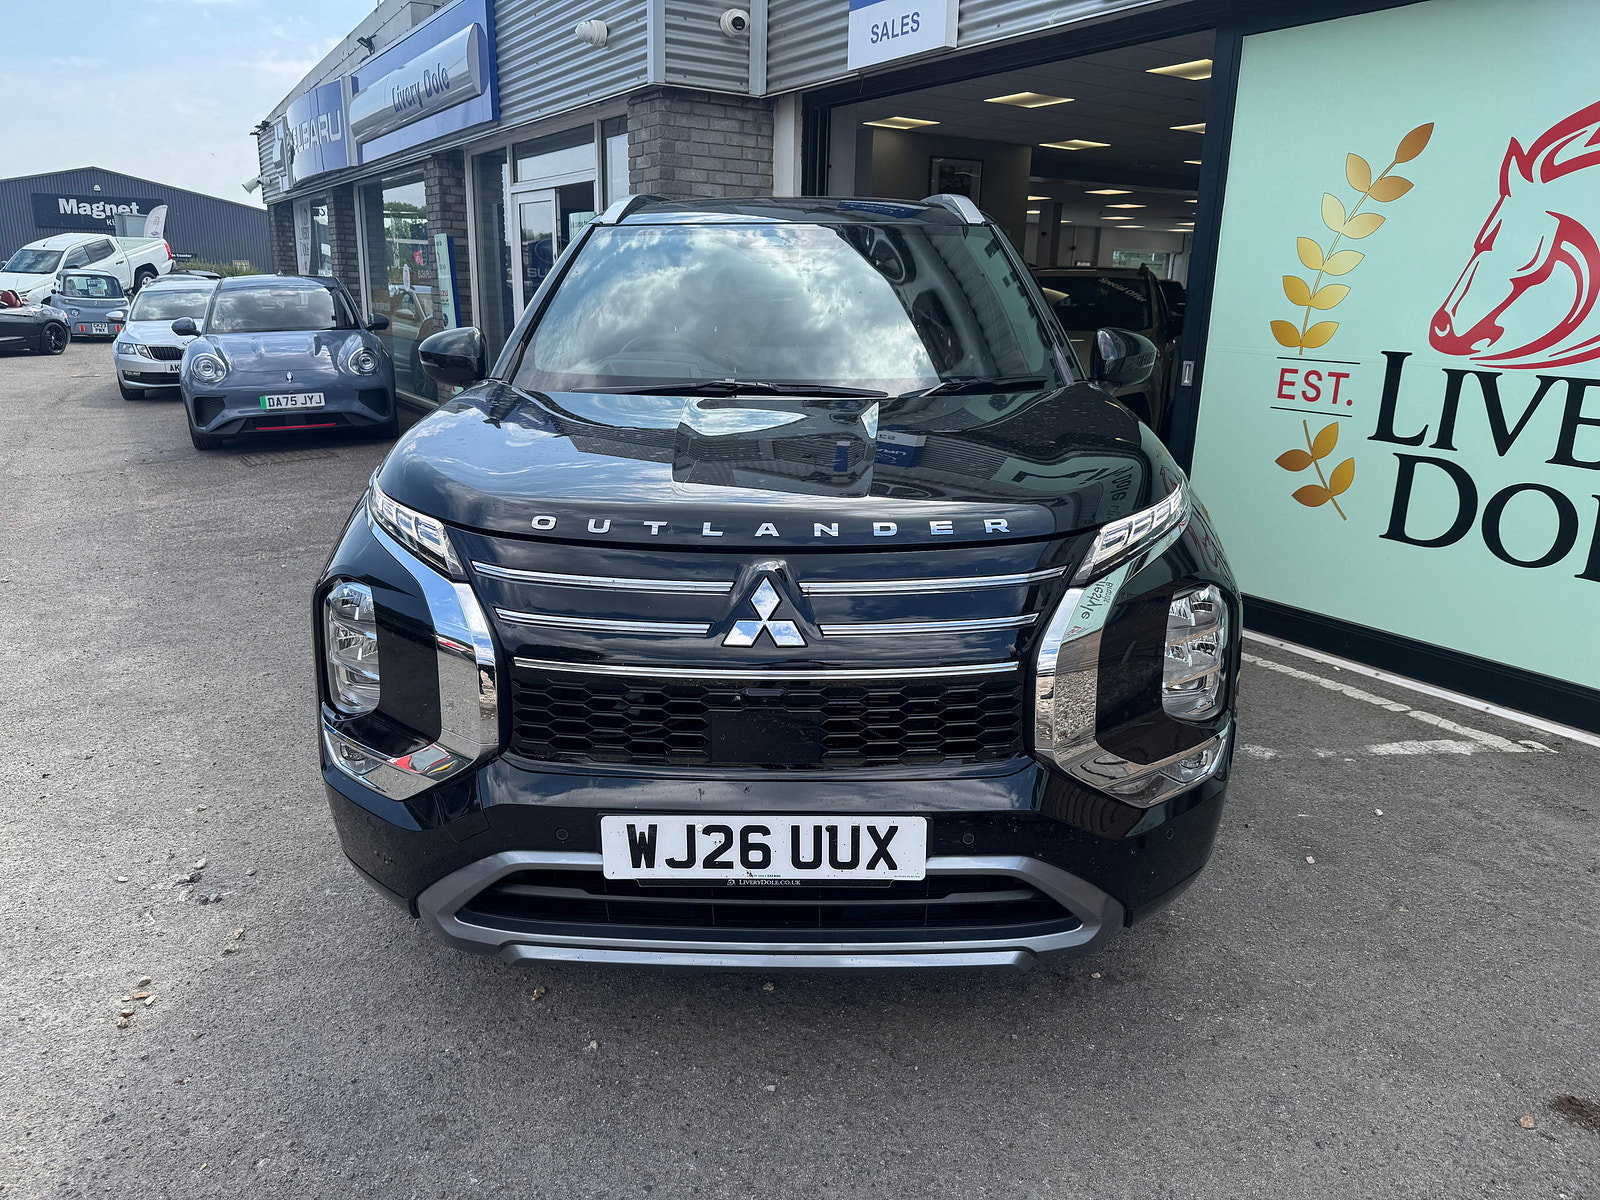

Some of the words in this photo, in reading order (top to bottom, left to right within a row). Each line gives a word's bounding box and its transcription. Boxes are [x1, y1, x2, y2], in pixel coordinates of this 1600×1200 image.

[870, 11, 920, 44] SALES
[391, 81, 424, 113] Livery
[423, 62, 450, 98] Dole
[58, 198, 140, 219] Magnet
[267, 396, 297, 408] DA75
[300, 394, 323, 406] JYJ
[1276, 367, 1353, 407] EST.
[531, 515, 1010, 538] OUTLANDER
[625, 823, 772, 870] WJ26
[790, 824, 899, 871] UUX
